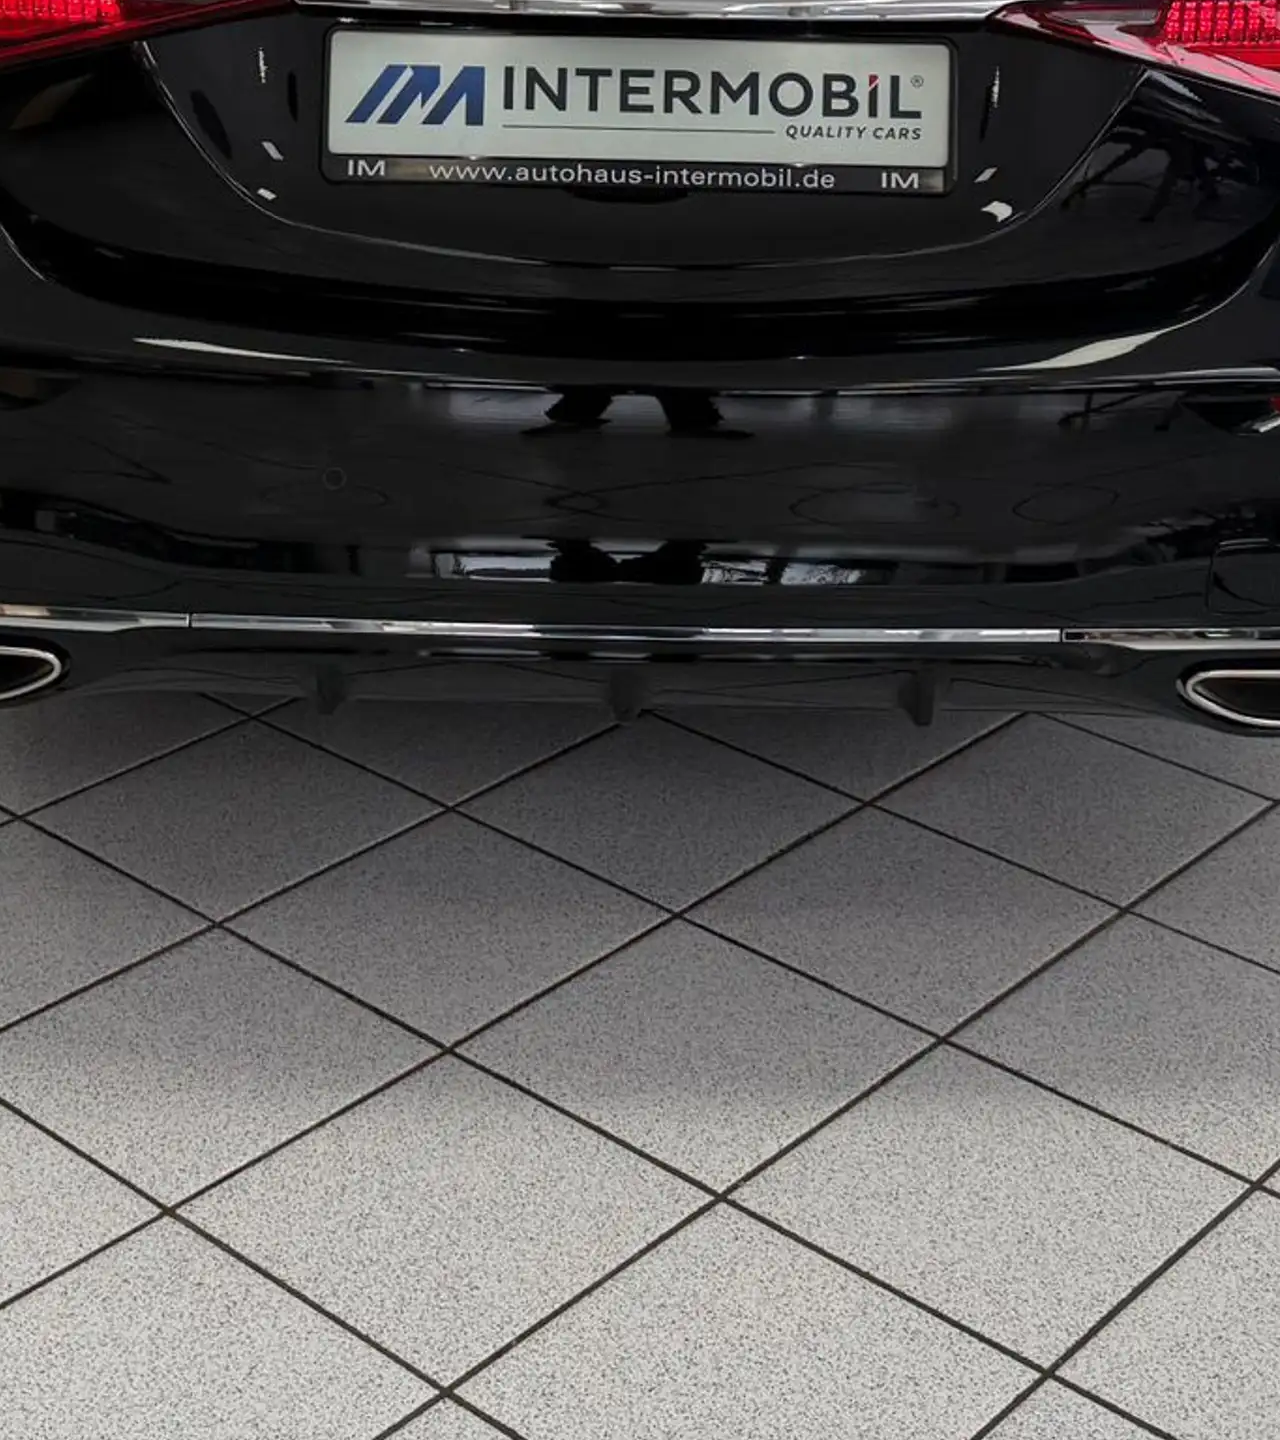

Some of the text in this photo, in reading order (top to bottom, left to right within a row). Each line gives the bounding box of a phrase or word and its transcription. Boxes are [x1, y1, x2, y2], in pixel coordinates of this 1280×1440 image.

[785, 124, 922, 142] QUALITY CARS
[347, 159, 920, 190] IM www.autohaus-intermobil.de IM
